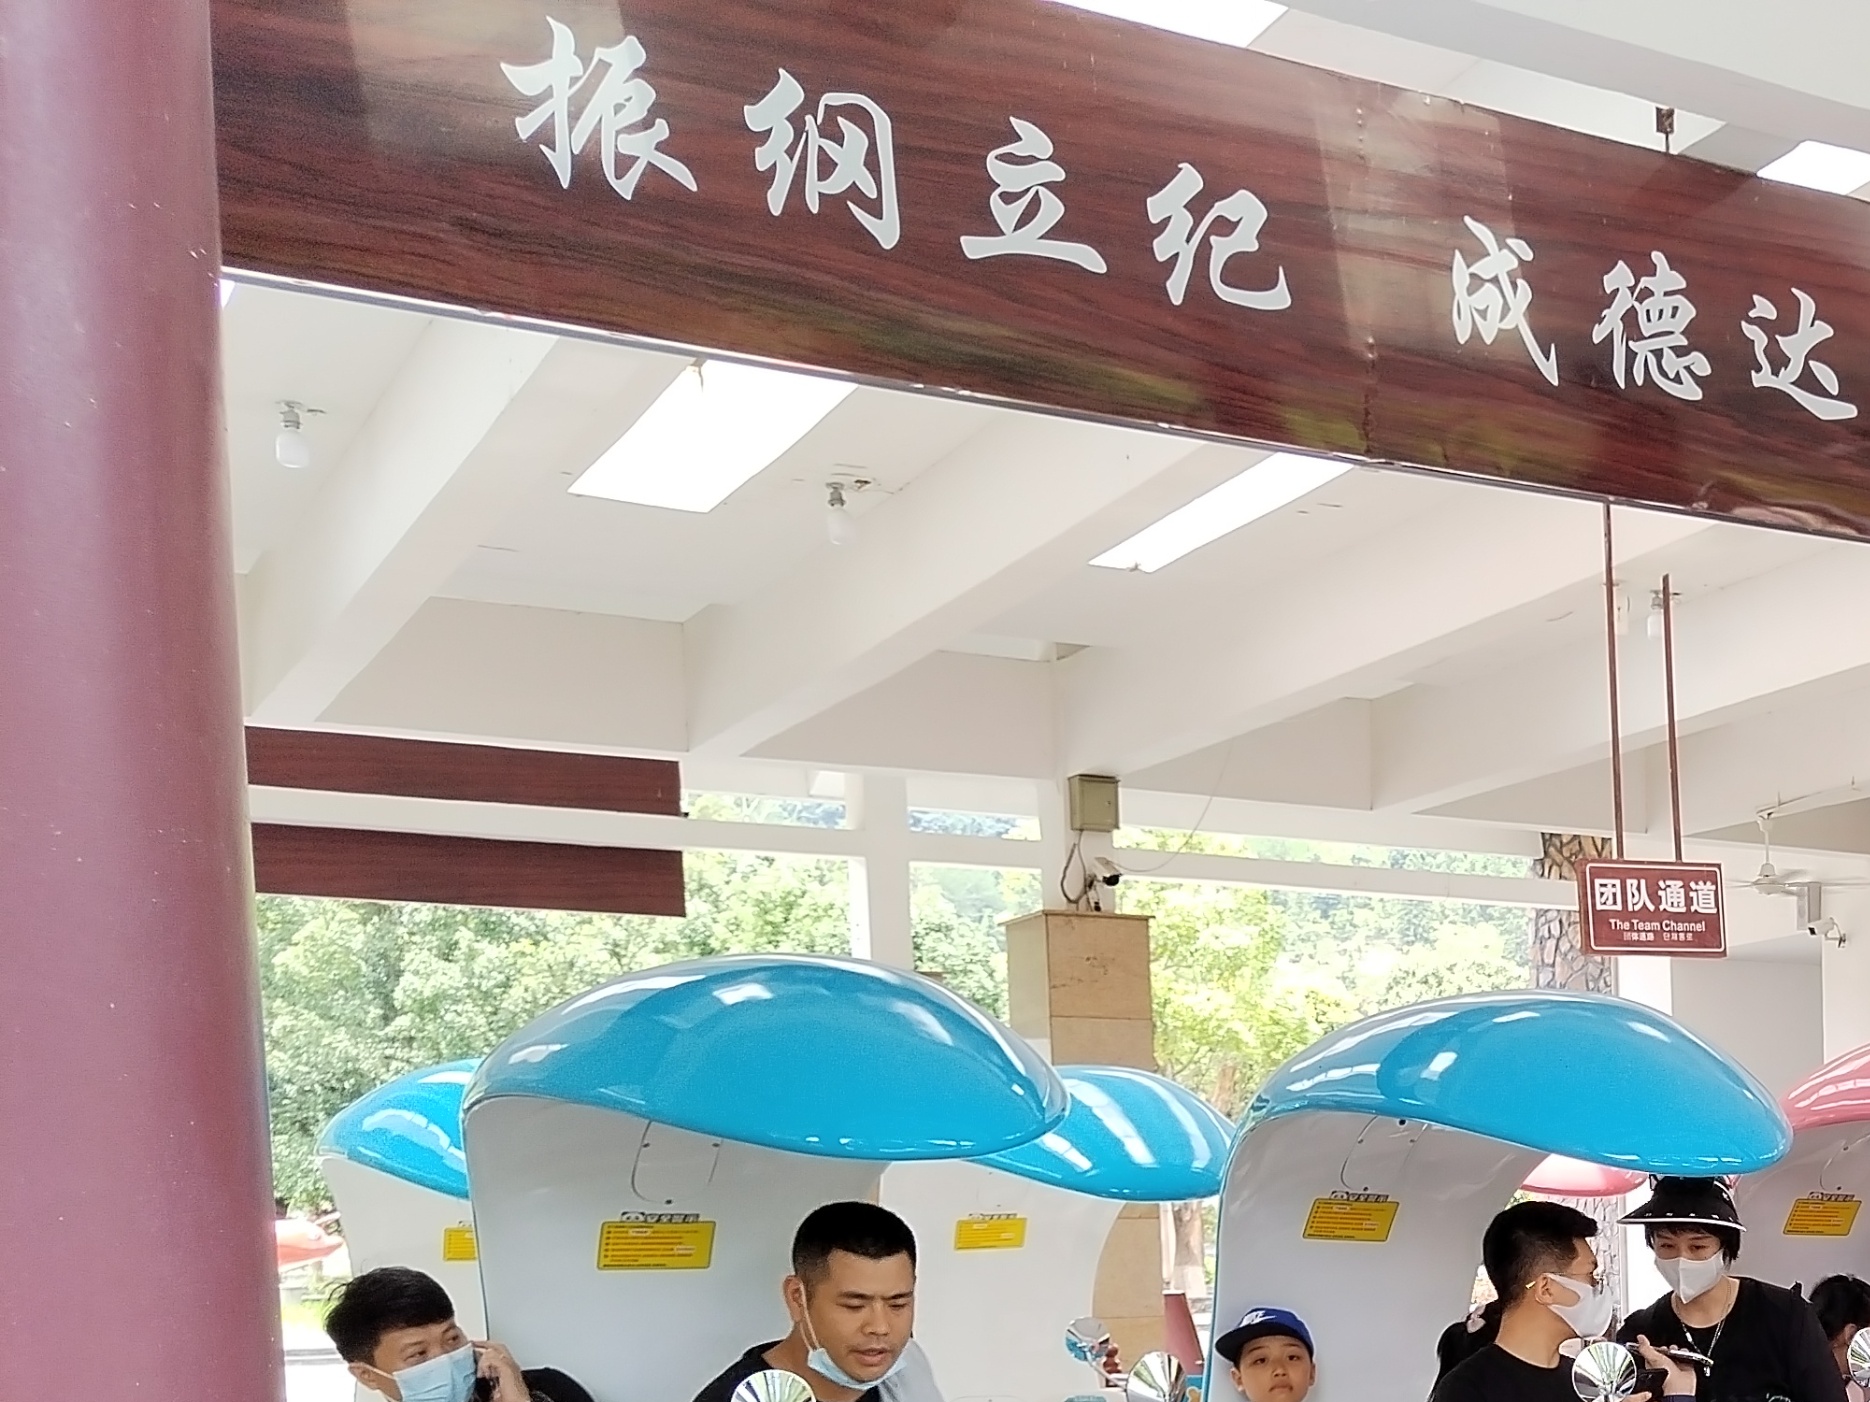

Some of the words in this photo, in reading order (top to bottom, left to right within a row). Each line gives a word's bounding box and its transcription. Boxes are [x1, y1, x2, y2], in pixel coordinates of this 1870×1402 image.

[500, 14, 1292, 312] 振纲立纪
[1594, 878, 1718, 914] 团队通道
[1609, 918, 1630, 931] The
[1631, 919, 1661, 932] Team
[1662, 920, 1706, 932] Channel
